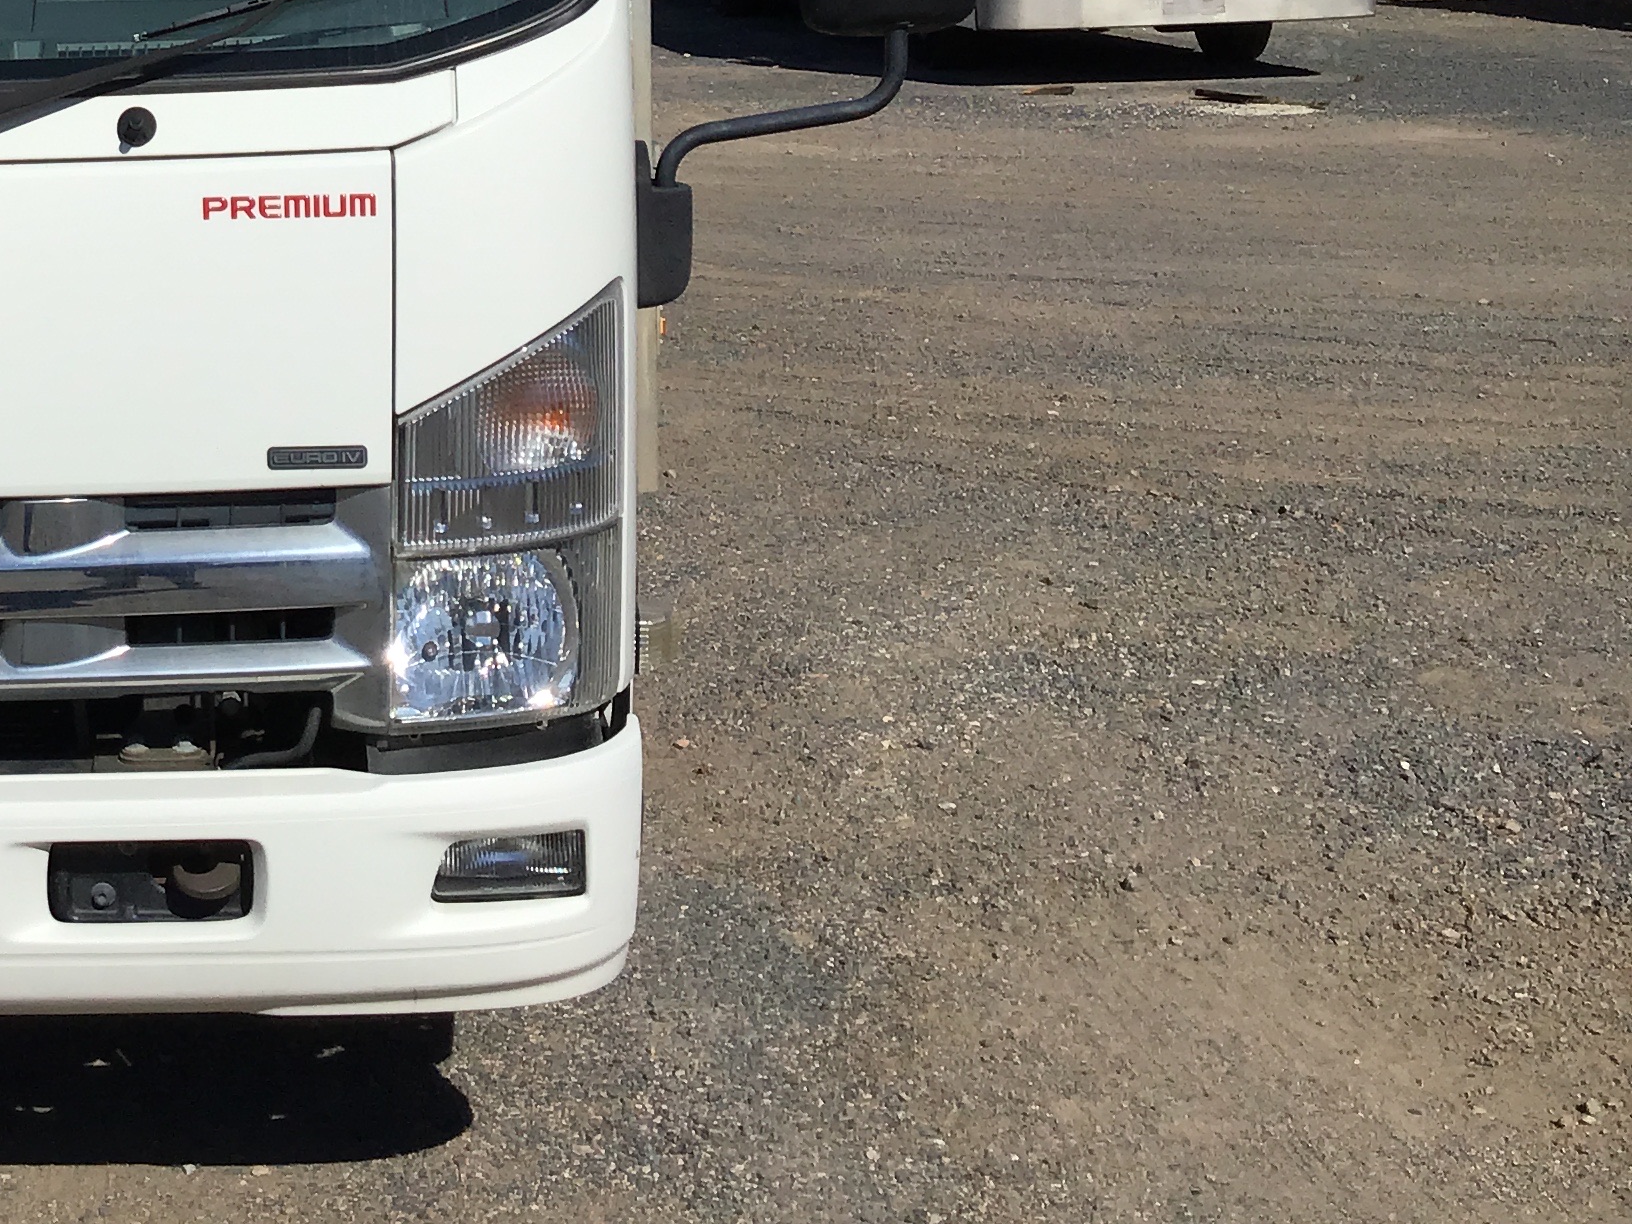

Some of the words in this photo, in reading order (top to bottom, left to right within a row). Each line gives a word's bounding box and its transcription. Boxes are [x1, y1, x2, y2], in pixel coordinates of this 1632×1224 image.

[202, 192, 377, 220] PREMIUM
[272, 450, 338, 465] EURO
[341, 449, 362, 464] IV
